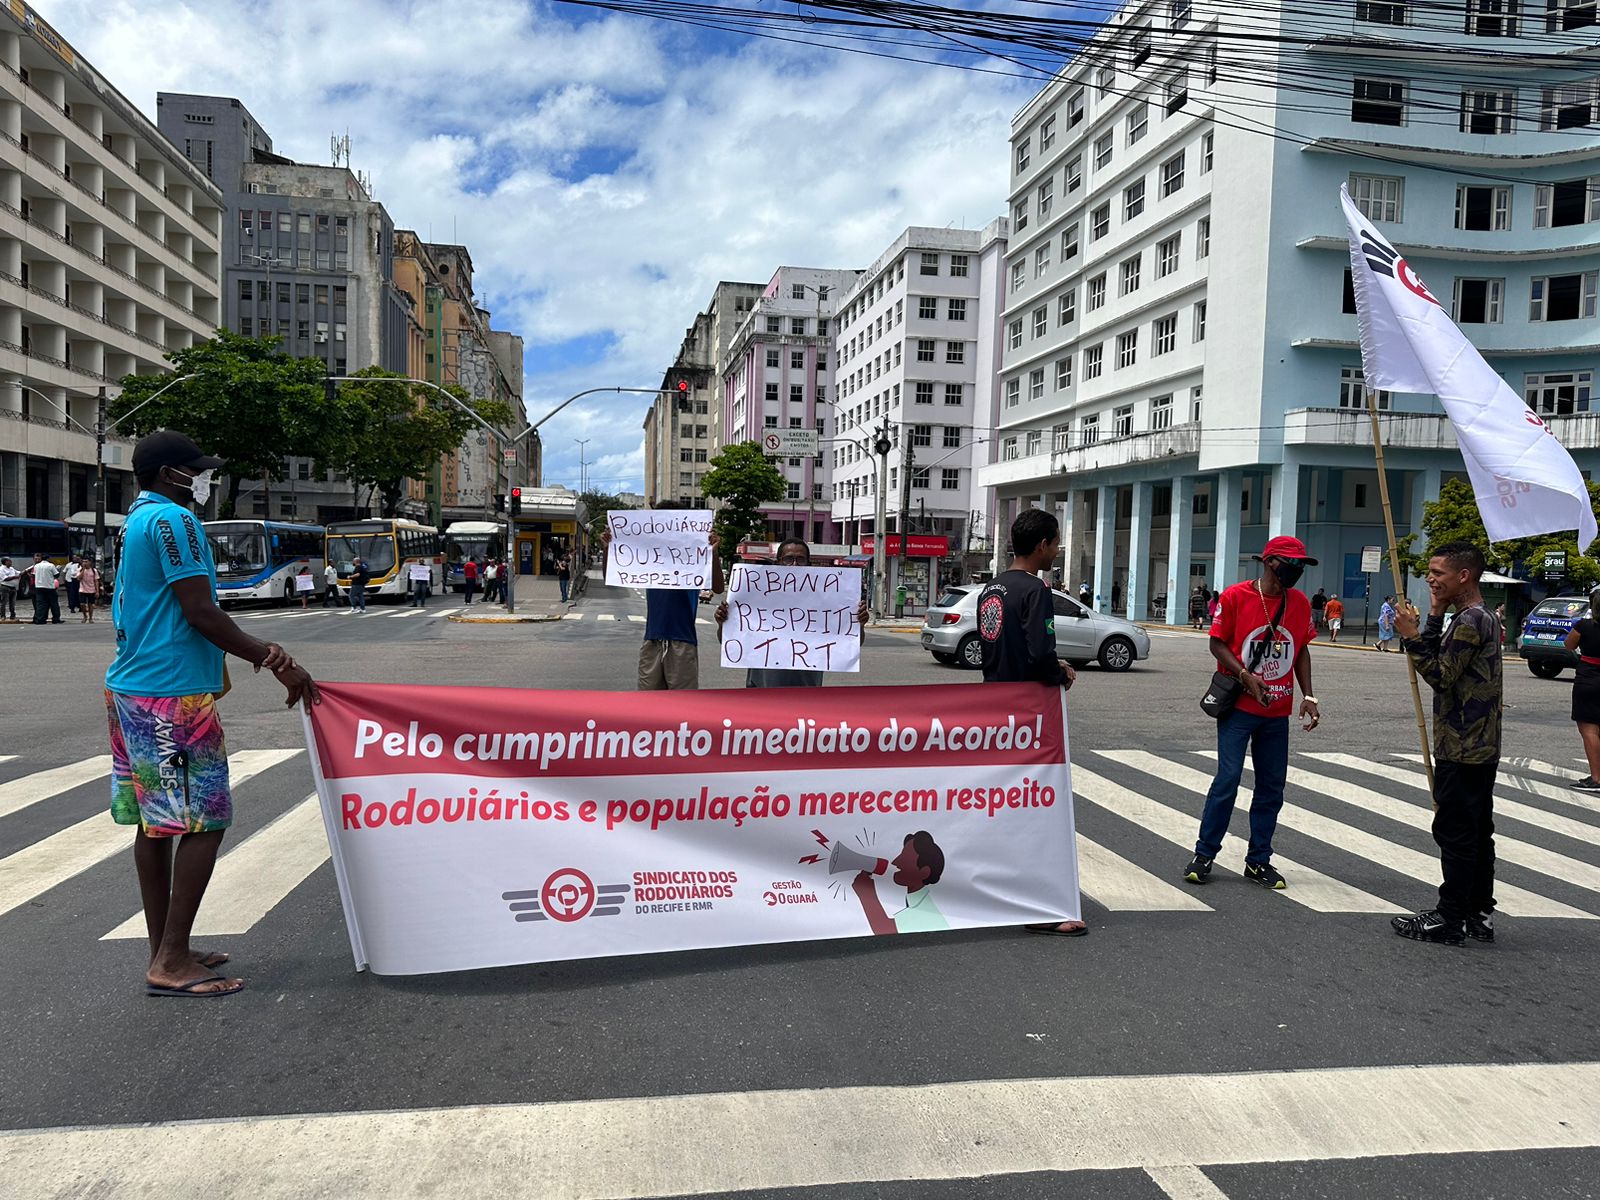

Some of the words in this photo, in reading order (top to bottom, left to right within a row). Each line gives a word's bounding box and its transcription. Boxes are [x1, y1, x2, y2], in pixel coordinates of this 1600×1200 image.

[158, 519, 182, 567] NETSHOES
[181, 513, 201, 562] NETSHOES
[735, 600, 859, 637] RESPEITE
[725, 639, 743, 663] O
[155, 716, 178, 789] SEAWAY
[354, 719, 444, 759] Pelo
[453, 719, 713, 770] cumprimento
[720, 718, 871, 756] imediato
[878, 717, 918, 752] do
[922, 714, 1043, 751] Acordo!
[341, 787, 571, 830] Rodoviários
[578, 800, 598, 822] e
[606, 785, 791, 831] população
[798, 788, 938, 816] merecem
[945, 777, 1055, 817] respeito
[633, 871, 707, 885] SINDICATO
[708, 871, 738, 883] DOS
[634, 884, 734, 902] RODOVIÁRIOS
[771, 880, 802, 889] GESTÃO
[635, 905, 649, 914] DO
[651, 903, 683, 914] RECIFE
[685, 902, 691, 911] E
[692, 901, 713, 910] RMR
[786, 891, 818, 904] GUARÁ
